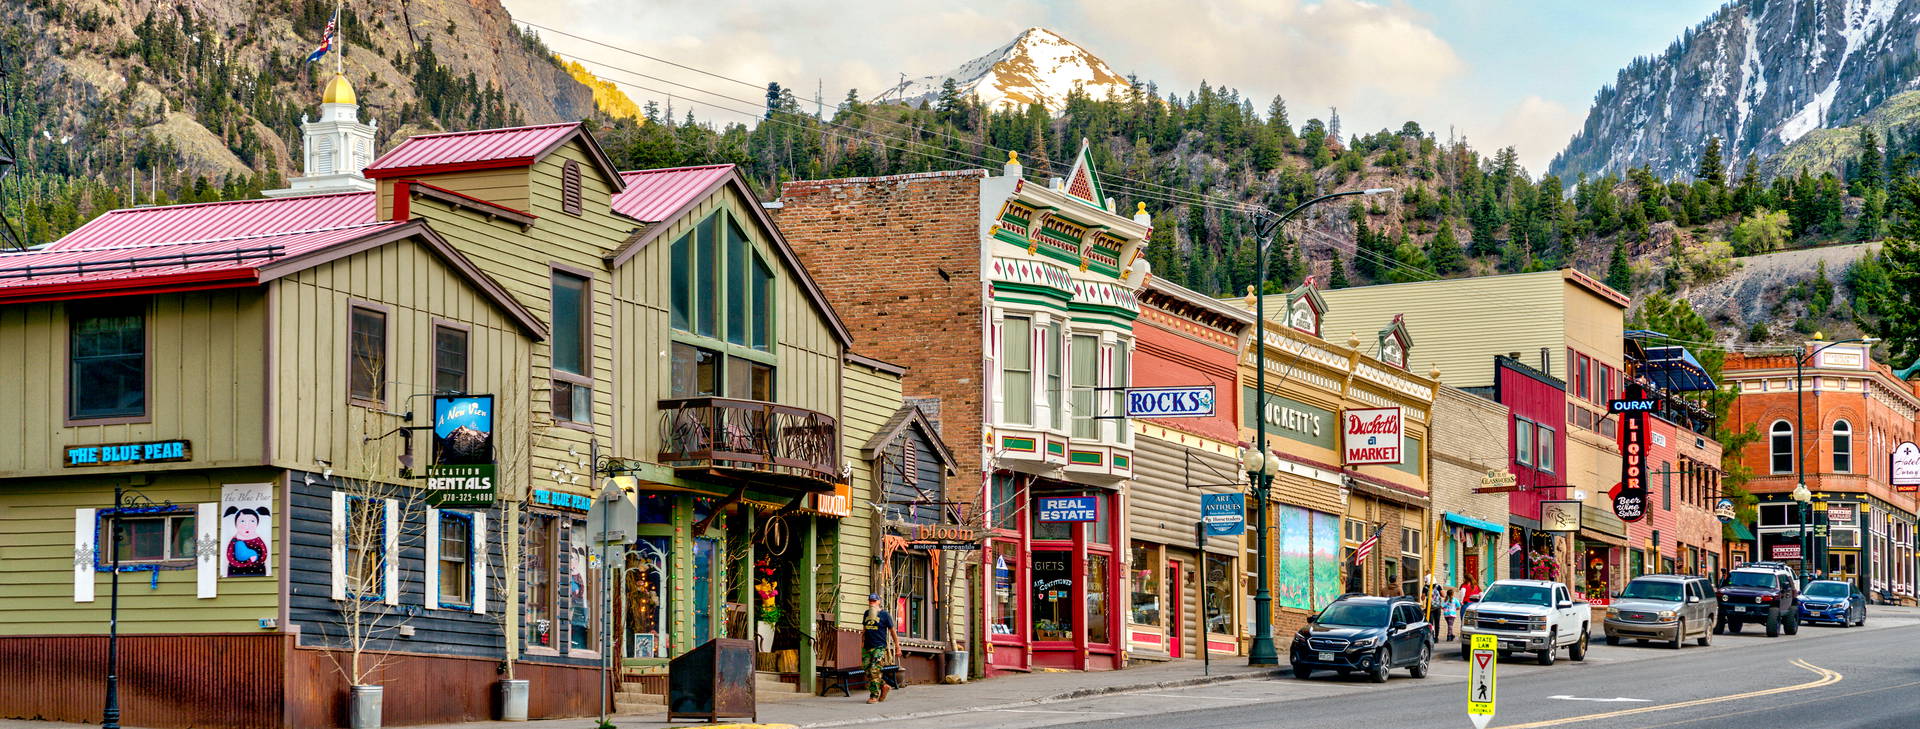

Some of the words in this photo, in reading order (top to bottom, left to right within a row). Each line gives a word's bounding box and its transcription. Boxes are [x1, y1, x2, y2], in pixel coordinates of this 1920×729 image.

[1130, 391, 1201, 413] ROCKS
[1614, 400, 1655, 411] OURAY
[447, 406, 466, 420] New
[468, 402, 488, 417] View
[1264, 403, 1320, 437] UCKETT'S
[1348, 413, 1399, 436] Duckett's
[68, 447, 99, 465] THE
[102, 444, 142, 462] BLUE
[143, 442, 185, 460] PEAR
[1349, 447, 1398, 461] MARKET
[1627, 418, 1641, 489] LIQUOR
[427, 477, 492, 490] RENTALS
[534, 489, 551, 504] THE
[552, 491, 571, 507] BLUE
[571, 494, 591, 511] PEAR
[1047, 499, 1087, 509] REAL
[1617, 496, 1641, 505] Beer
[1205, 503, 1241, 512] ANTIQUES
[1616, 504, 1640, 512] Wine
[1041, 510, 1095, 520] ESTATE
[1618, 511, 1641, 519] Spirits
[919, 524, 974, 540] bloom
[1034, 561, 1065, 571] GIFTS
